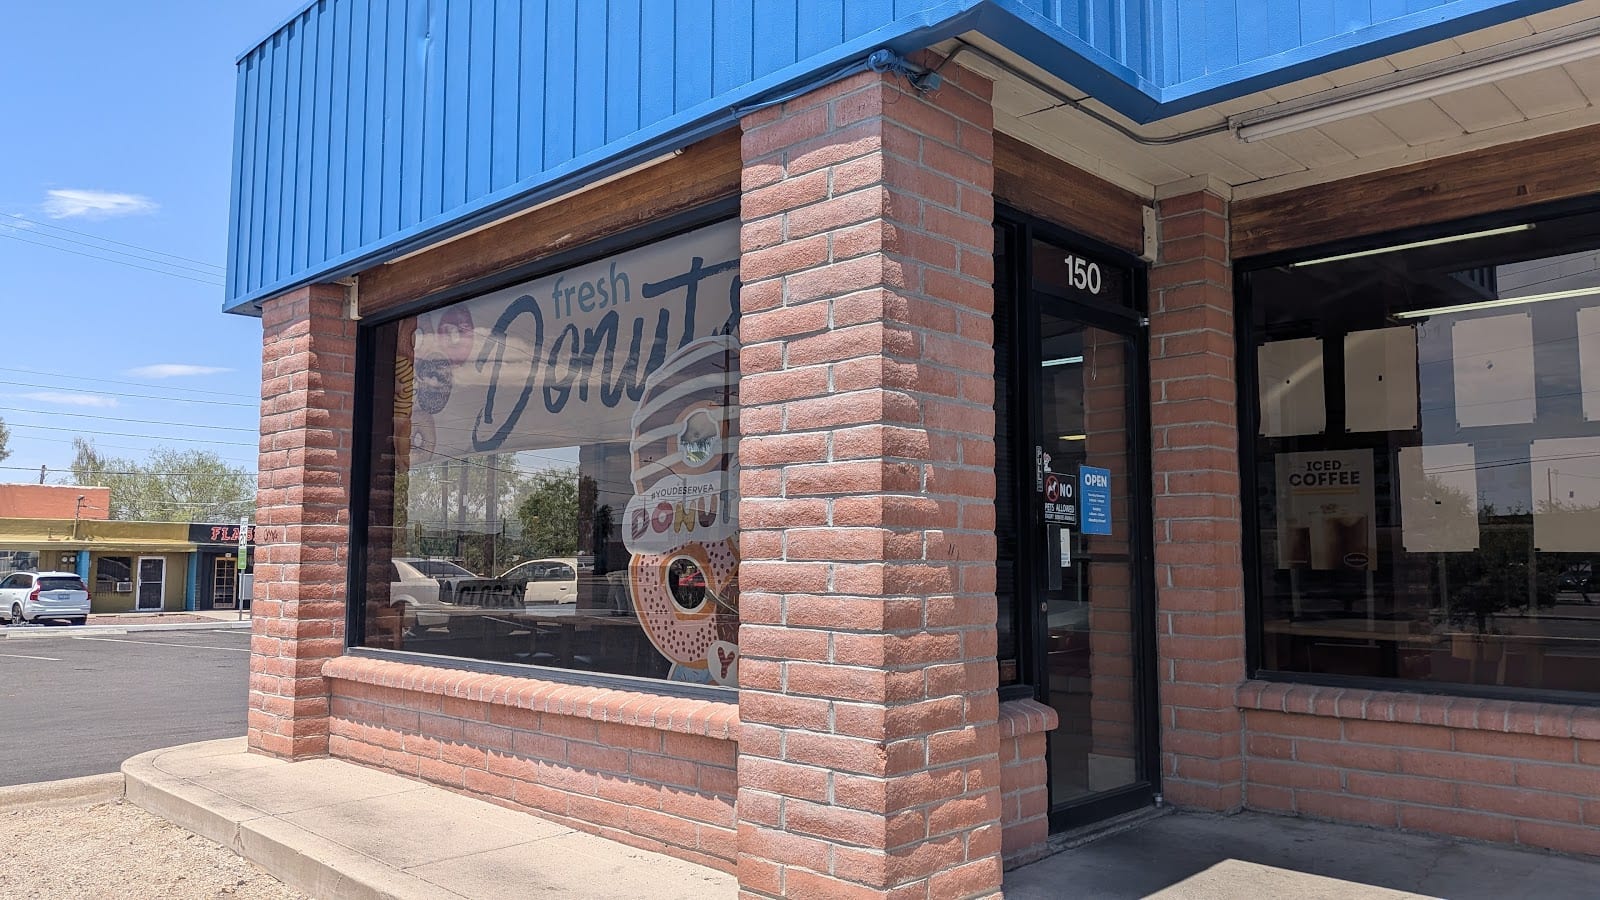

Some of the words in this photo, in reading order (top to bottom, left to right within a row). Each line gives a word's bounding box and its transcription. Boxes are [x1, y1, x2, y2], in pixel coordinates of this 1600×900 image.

[1065, 254, 1101, 294] 150
[552, 262, 630, 318] fresh
[1306, 460, 1342, 471] ICED
[1084, 473, 1107, 488] OPEN
[1289, 471, 1360, 486] COFFEE
[651, 484, 714, 499] #YOUDESERVEA
[1060, 483, 1072, 498] NO
[1045, 502, 1054, 511] PETS
[632, 490, 738, 540] DONUT
[211, 526, 255, 541] FLAS
